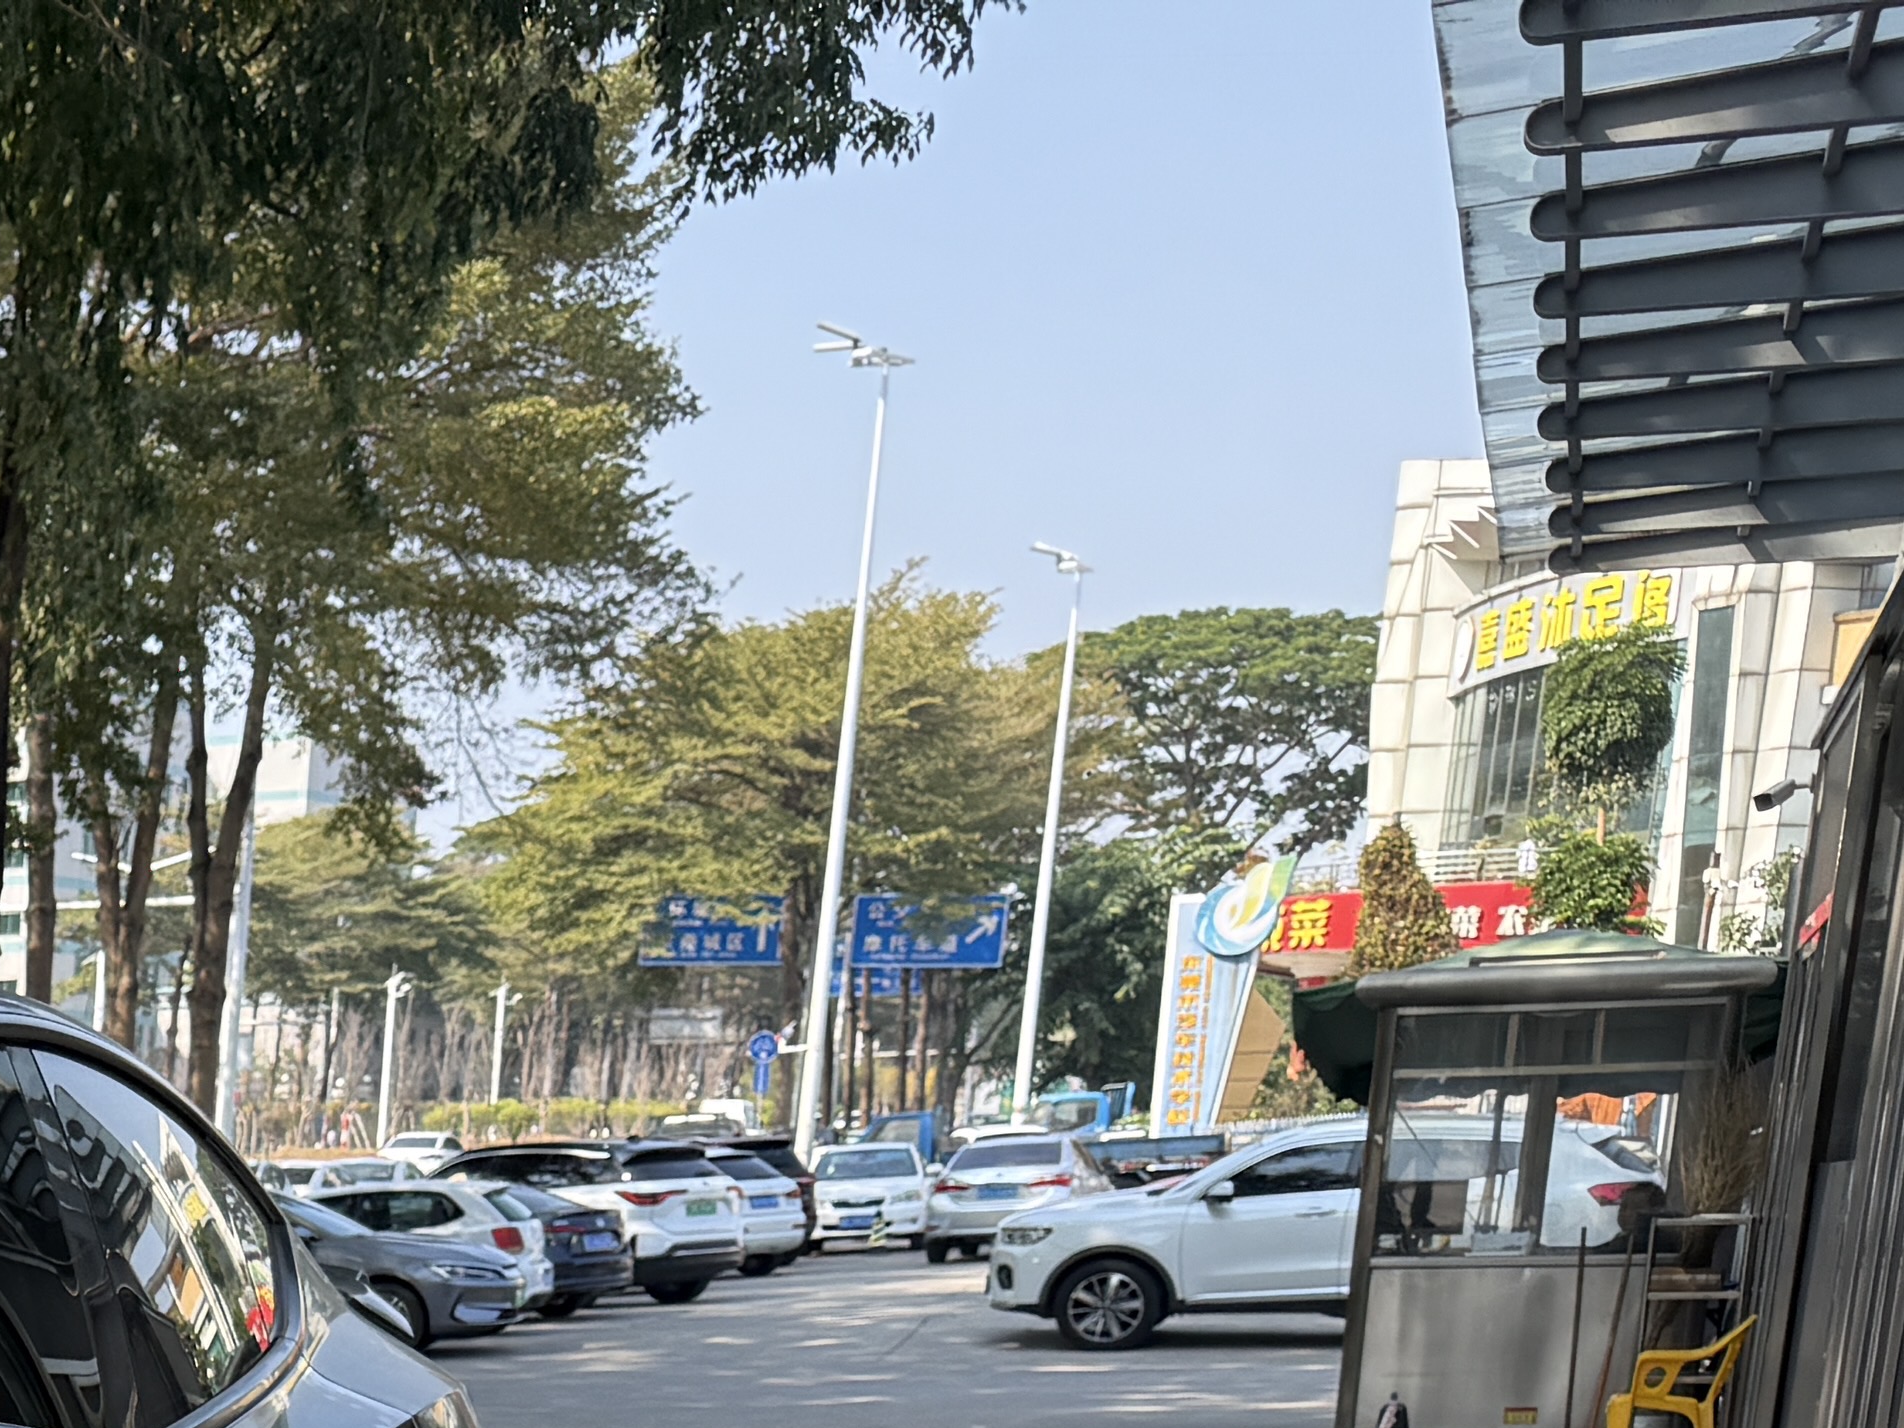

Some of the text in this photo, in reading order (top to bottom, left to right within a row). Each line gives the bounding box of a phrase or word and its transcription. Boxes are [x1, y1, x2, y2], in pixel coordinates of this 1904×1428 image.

[1476, 569, 1672, 672] 喜盛沐足阁
